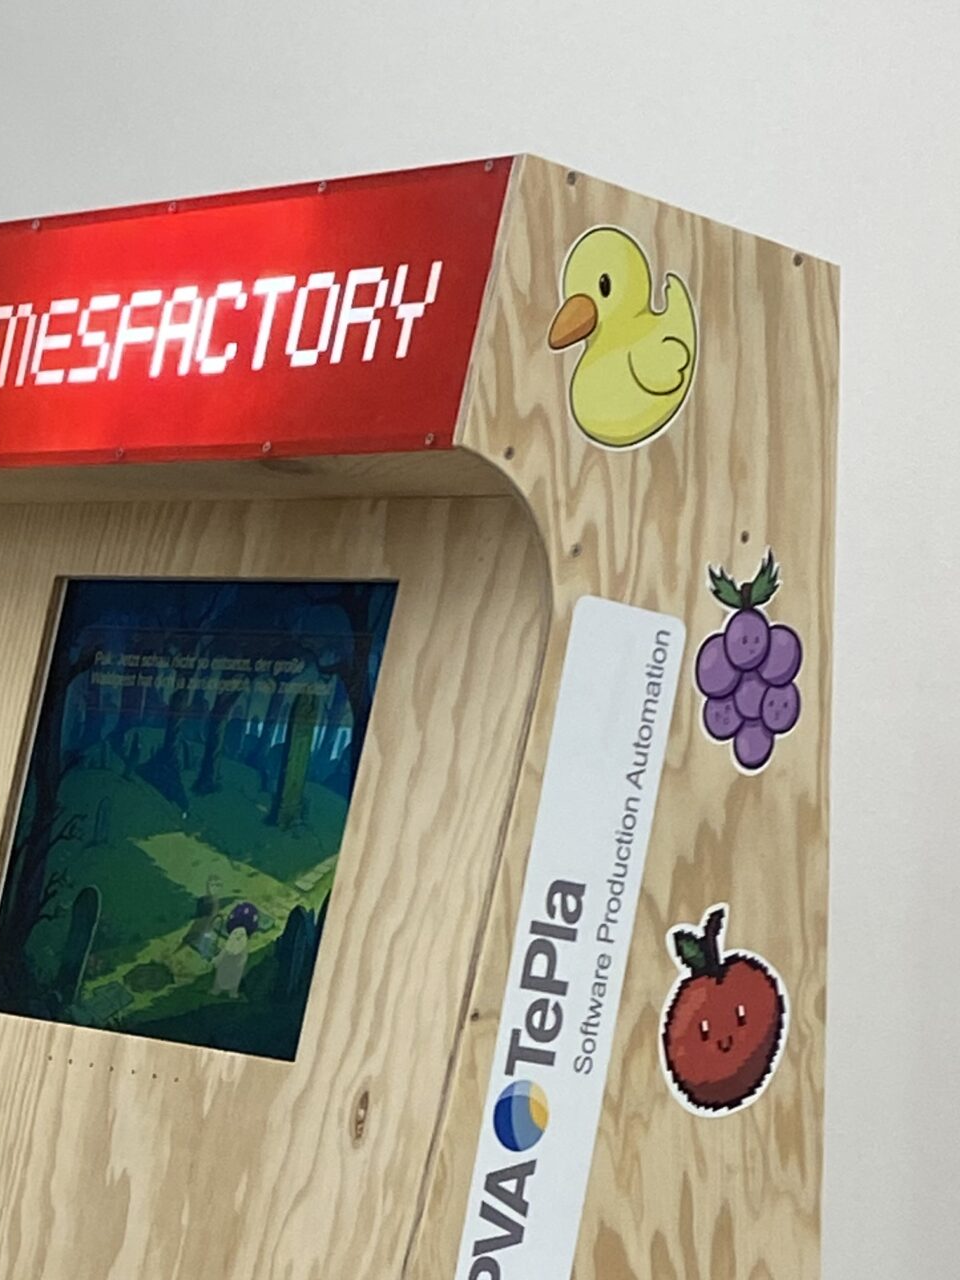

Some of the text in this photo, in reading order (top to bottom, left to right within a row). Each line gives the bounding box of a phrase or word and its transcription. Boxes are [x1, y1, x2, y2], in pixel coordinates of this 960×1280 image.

[504, 879, 586, 1076] TePla
[574, 629, 671, 1075] Software Production Automation
